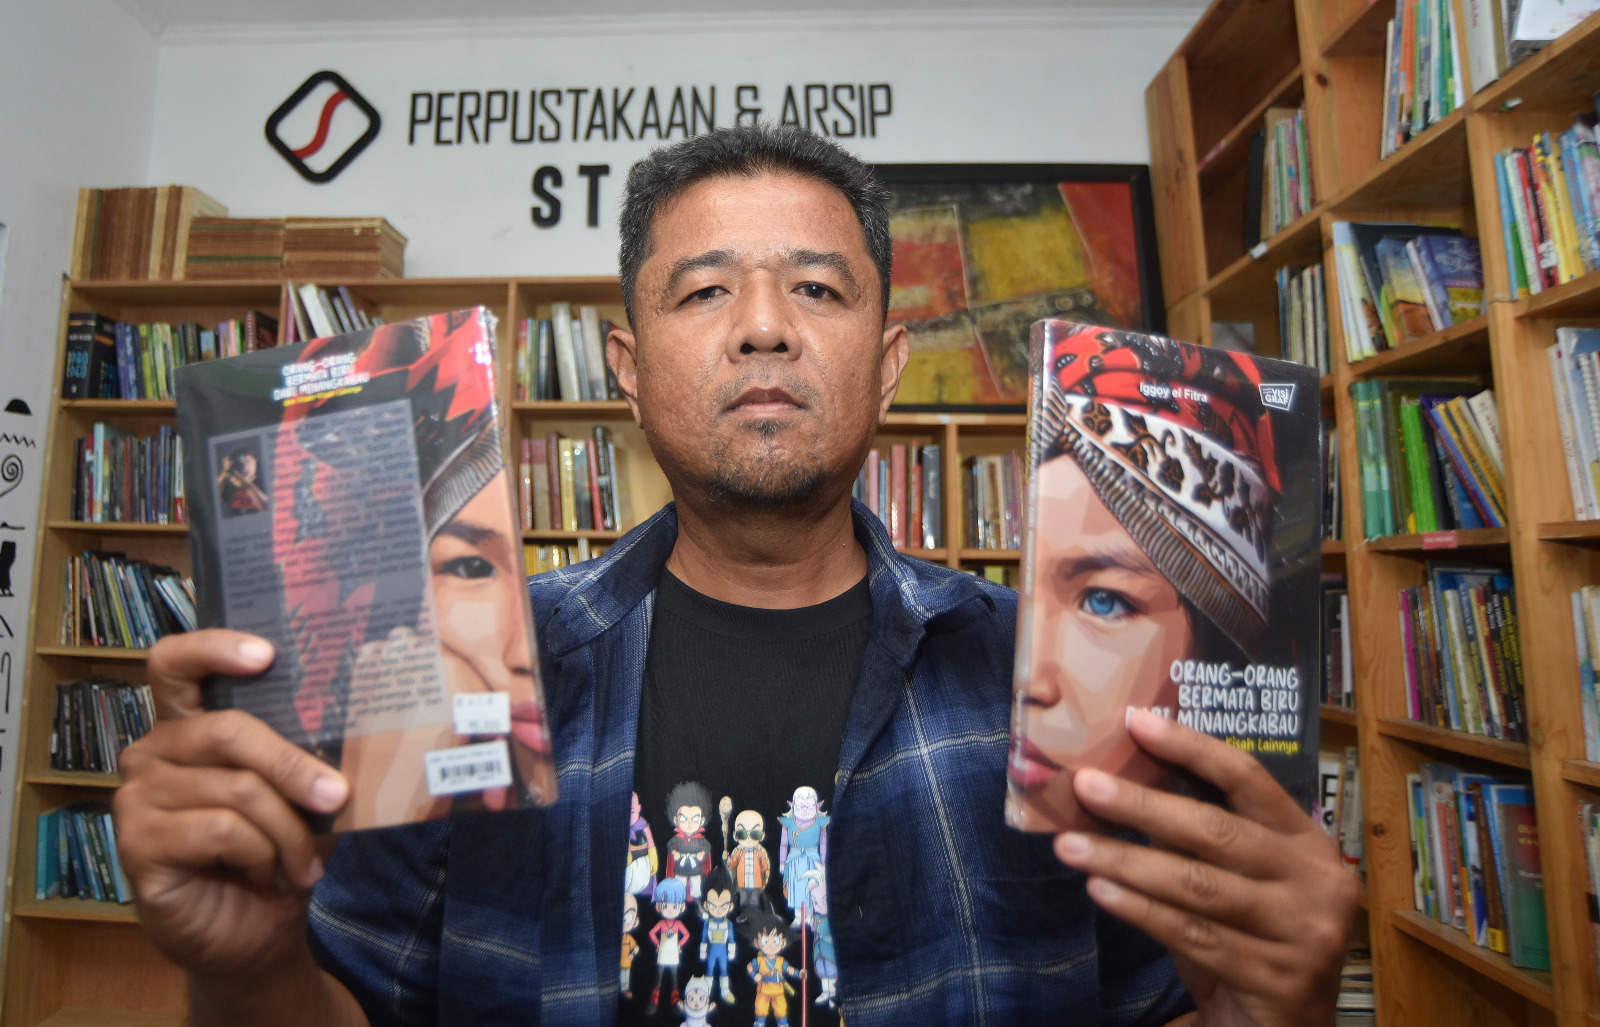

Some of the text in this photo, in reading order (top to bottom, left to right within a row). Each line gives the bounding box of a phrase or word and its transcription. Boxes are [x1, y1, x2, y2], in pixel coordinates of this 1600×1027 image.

[408, 84, 892, 145] PERPUSTAKAAN & ARSIP
[531, 164, 610, 228] ST
[1139, 382, 1208, 403] Iggoy el Fitra
[1169, 659, 1299, 690] ORANG-ORANG
[1178, 685, 1299, 712] BERMATA BIRU
[1177, 709, 1299, 736] MINANGKABAU
[1257, 737, 1299, 756] Lainnya
